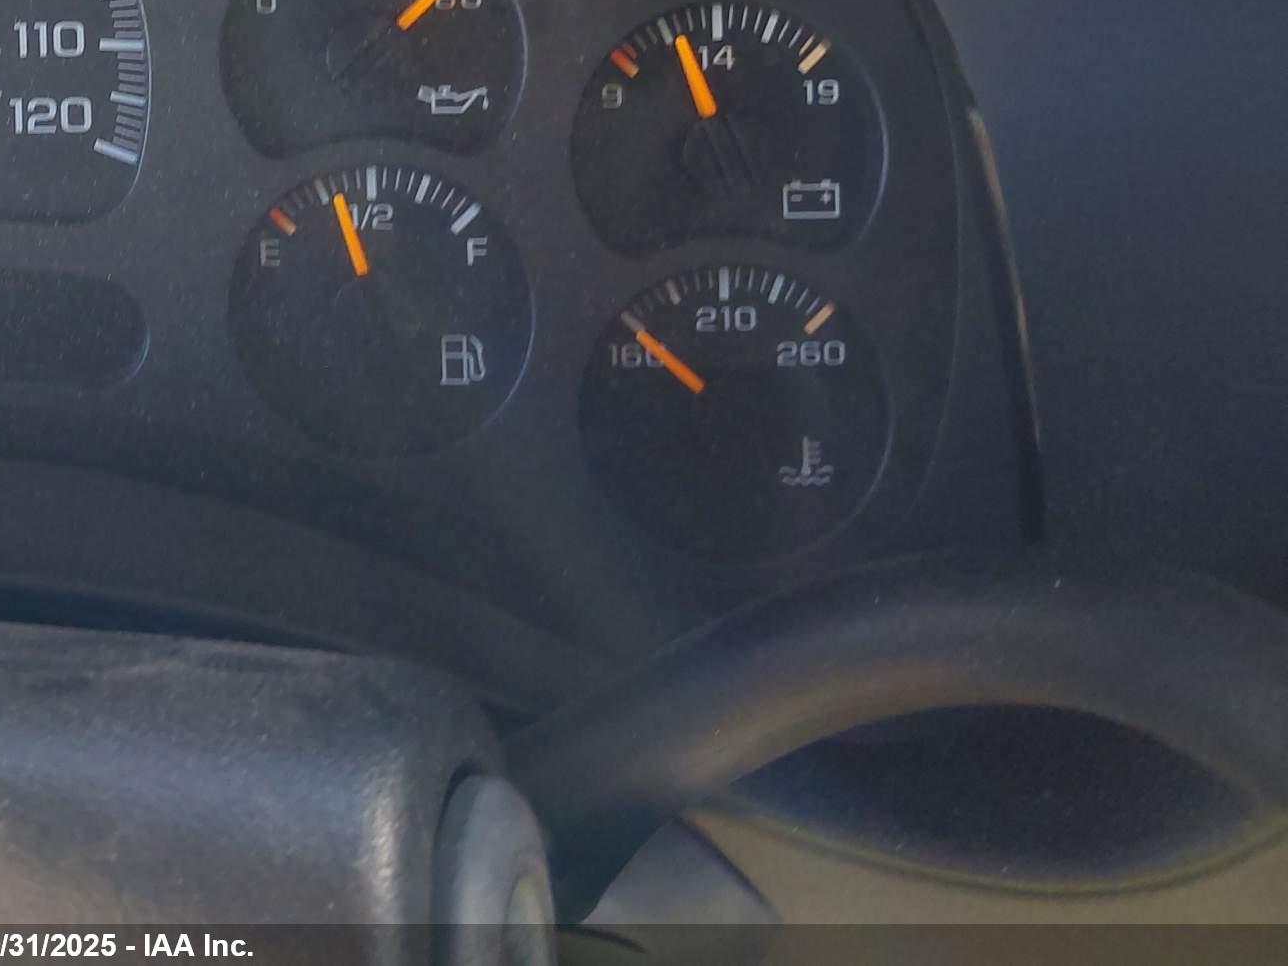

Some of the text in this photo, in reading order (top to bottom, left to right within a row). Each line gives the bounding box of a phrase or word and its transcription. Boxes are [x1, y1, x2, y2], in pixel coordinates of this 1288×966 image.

[14, 21, 85, 58] 110
[698, 46, 735, 71] 14
[601, 84, 622, 109] 9
[804, 80, 839, 105] 19
[10, 98, 92, 134] 120
[260, 241, 280, 267] E
[467, 237, 487, 265] F
[695, 306, 757, 331] 210
[777, 342, 845, 366] 260
